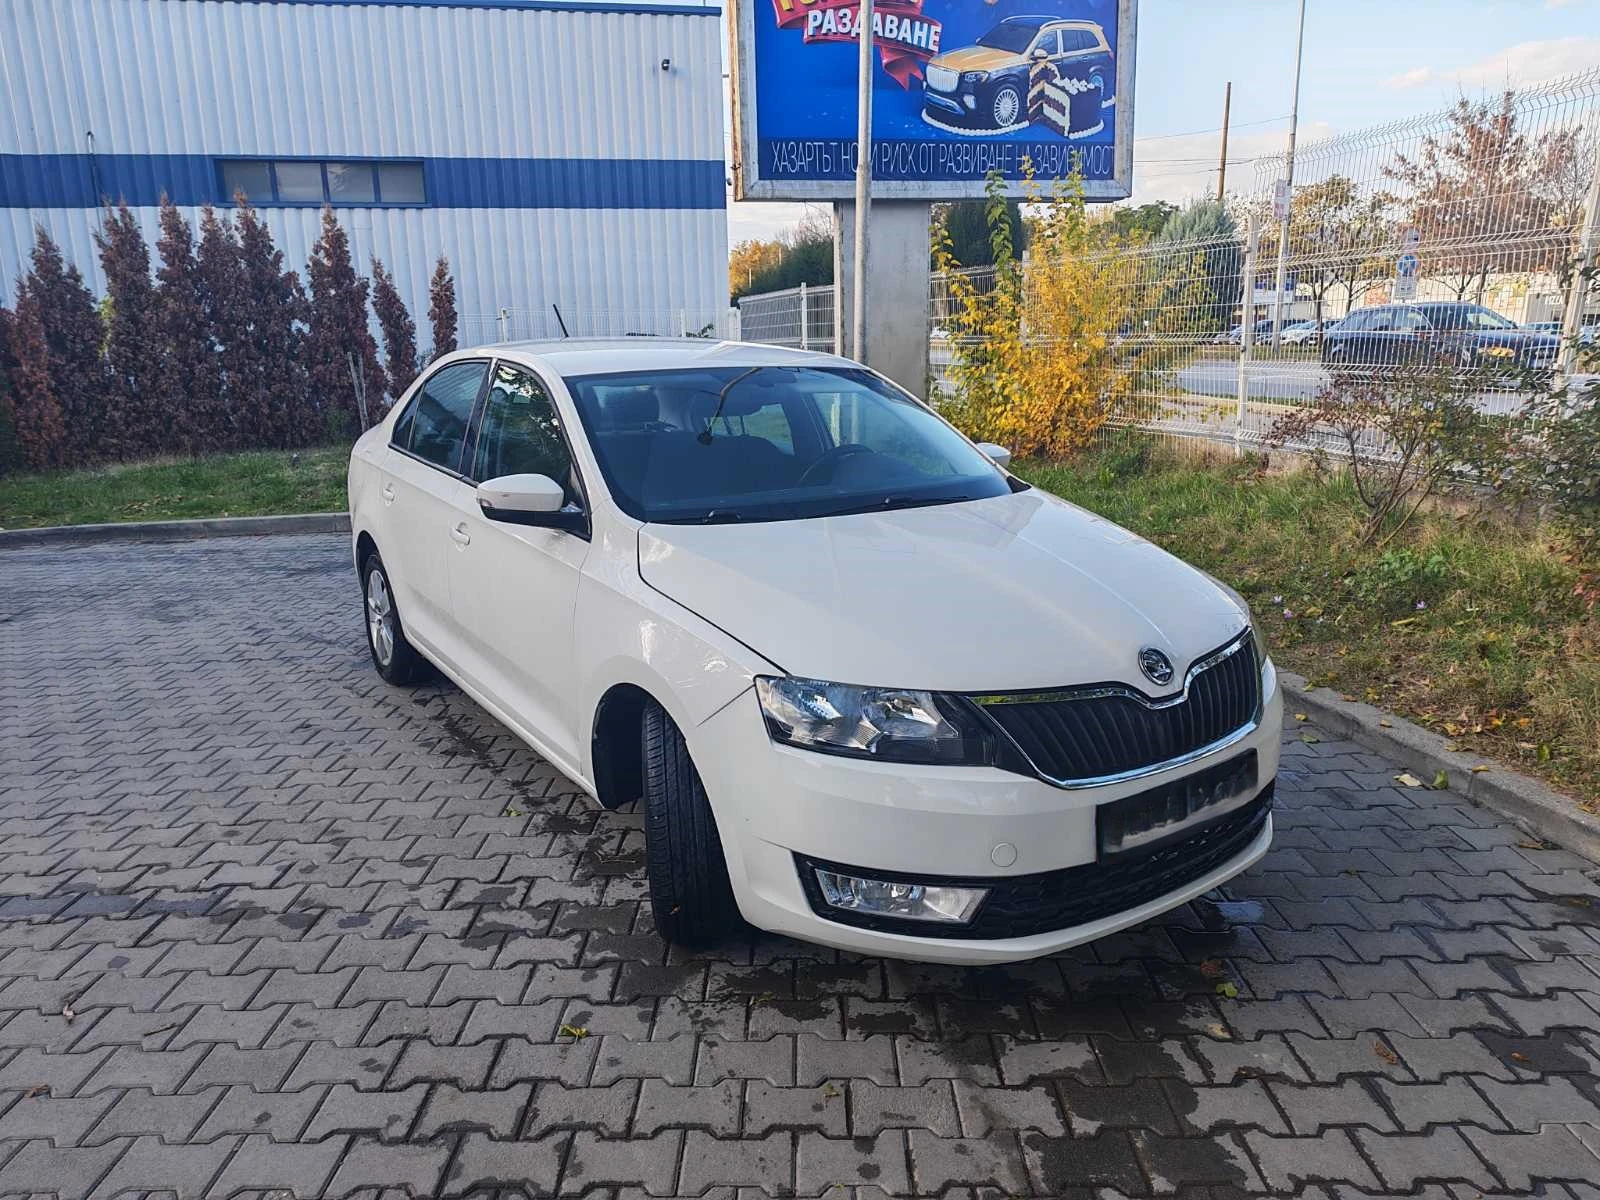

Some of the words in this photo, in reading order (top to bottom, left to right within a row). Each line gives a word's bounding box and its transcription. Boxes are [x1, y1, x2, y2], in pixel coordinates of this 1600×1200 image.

[771, 141, 838, 173] ХАЗАРТЪТ
[841, 142, 878, 173] НОИ
[882, 142, 917, 173] РИСК
[919, 143, 935, 173] ОТ
[939, 143, 1012, 174] РАЗВИВАНЕ
